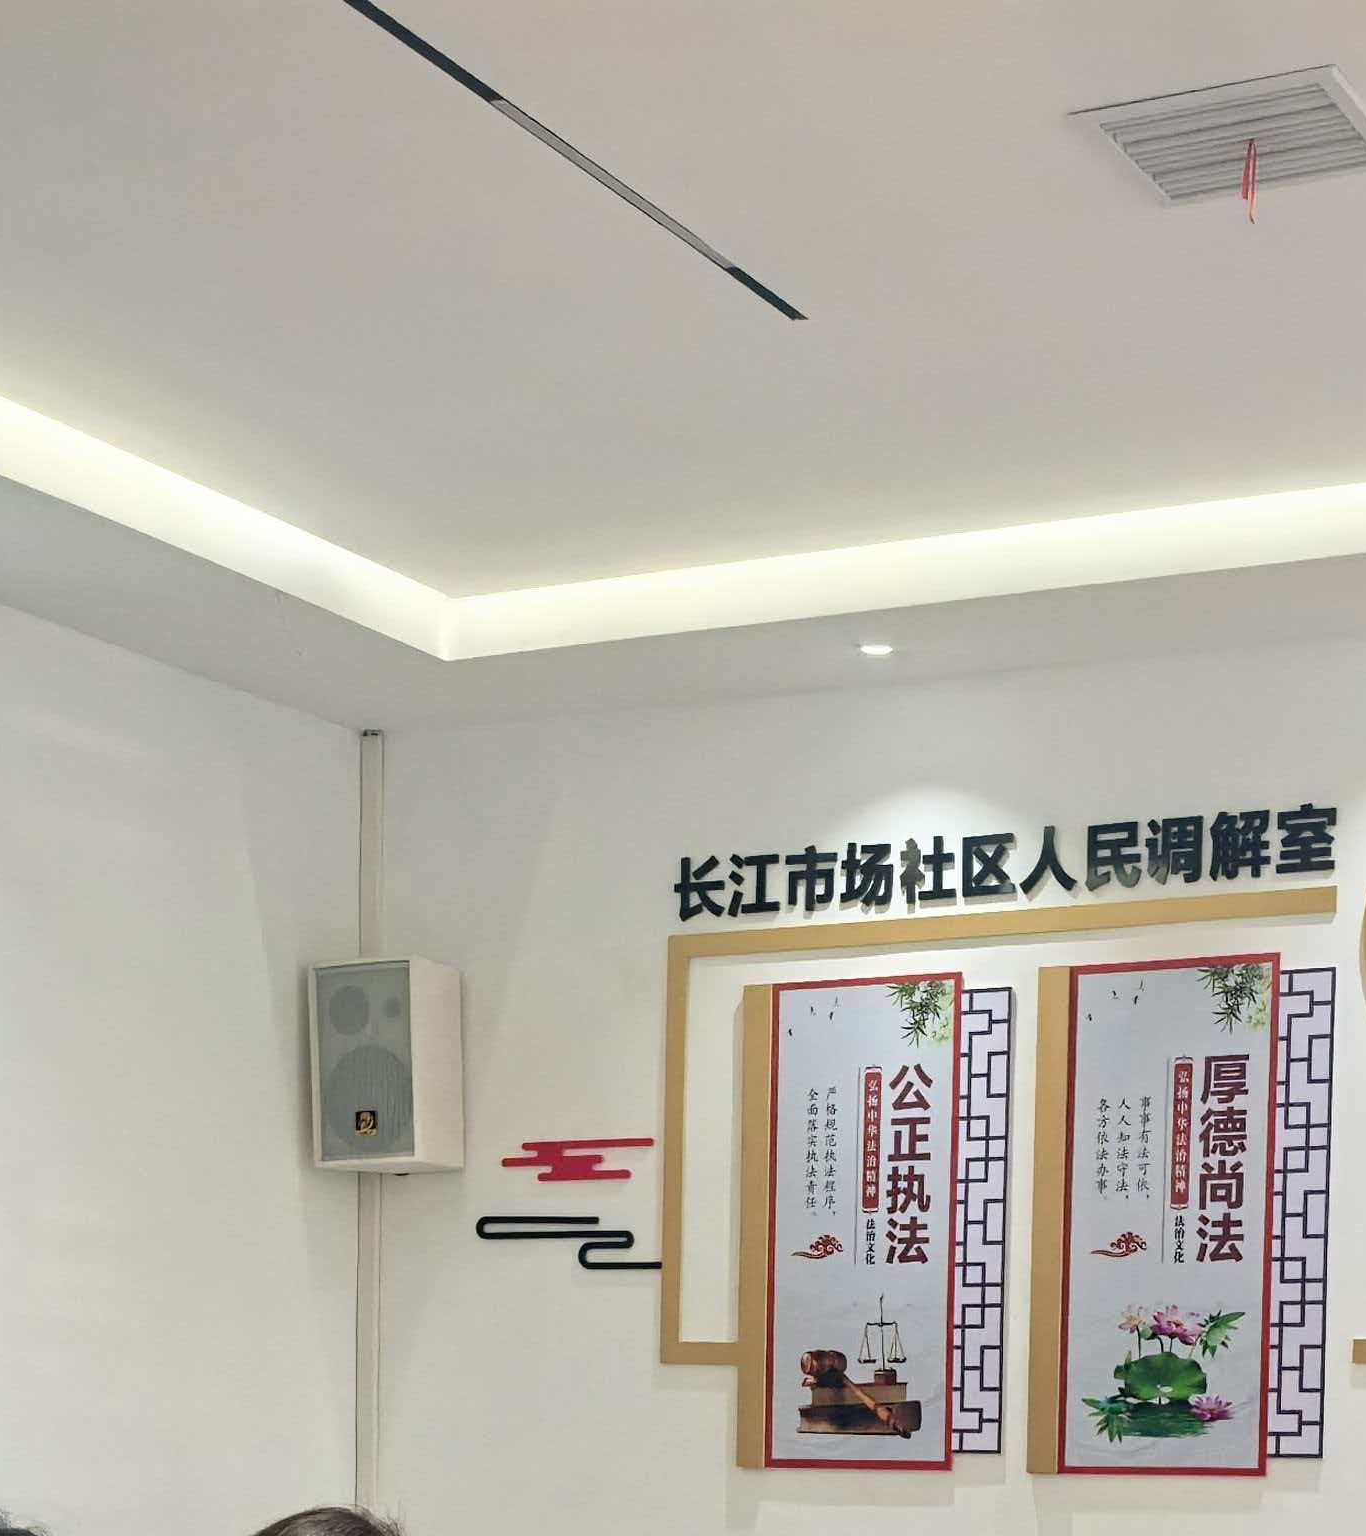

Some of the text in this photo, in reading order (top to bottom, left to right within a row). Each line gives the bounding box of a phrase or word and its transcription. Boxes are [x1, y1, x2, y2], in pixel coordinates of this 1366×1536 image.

[674, 804, 1338, 921] 长江市场社区人民调解室
[885, 1064, 933, 1265] 公正执法
[1196, 1054, 1249, 1263] 厚德尚法
[865, 1218, 876, 1265] 法治文化
[1173, 1215, 1185, 1264] 法治文化
